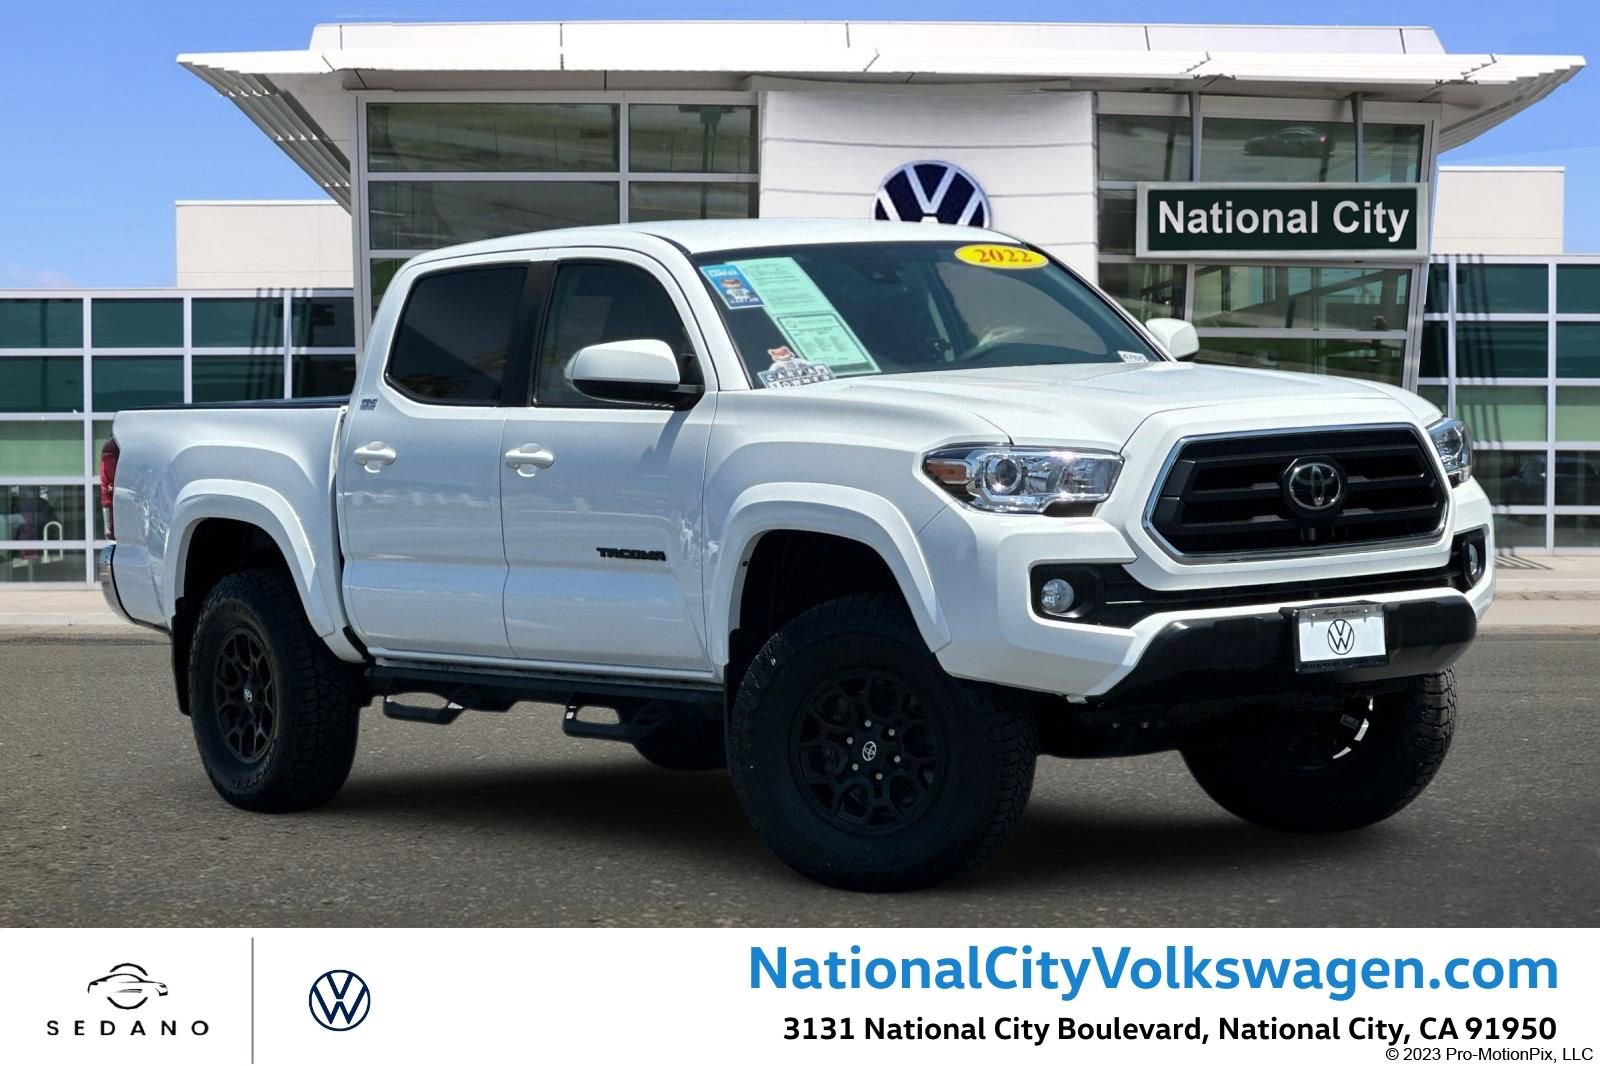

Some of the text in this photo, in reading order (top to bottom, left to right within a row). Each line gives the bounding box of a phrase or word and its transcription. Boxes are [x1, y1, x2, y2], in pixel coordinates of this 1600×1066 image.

[1158, 200, 1410, 243] National City
[975, 248, 1032, 263] 2022
[596, 547, 667, 562] TACOMA
